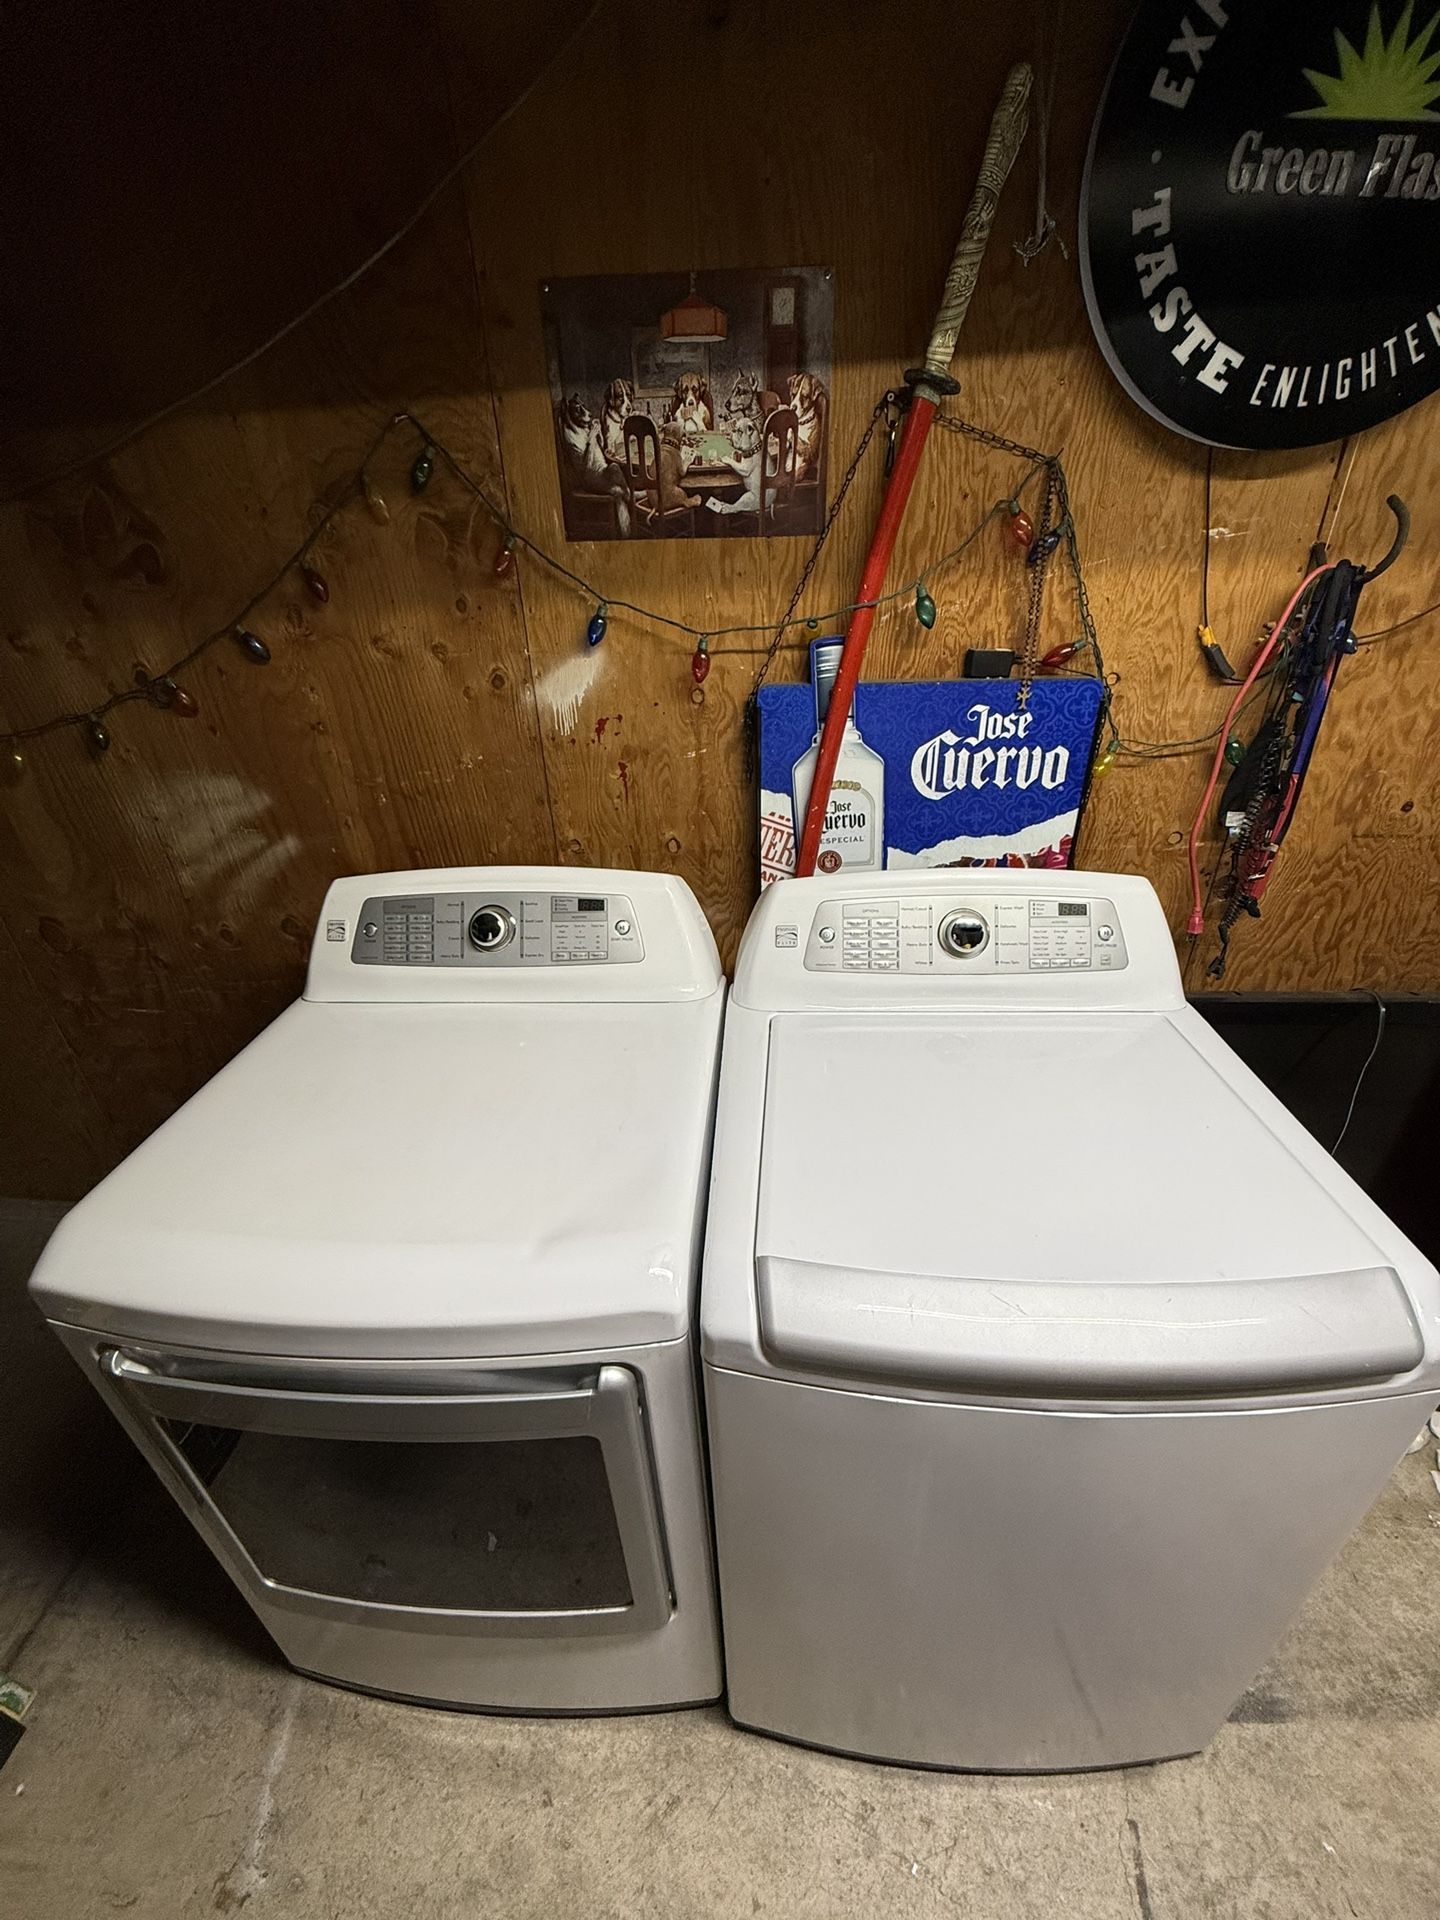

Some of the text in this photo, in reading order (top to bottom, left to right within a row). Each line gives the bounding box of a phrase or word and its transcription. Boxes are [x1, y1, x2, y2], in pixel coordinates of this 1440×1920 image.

[1226, 129, 1355, 196] Green
[1131, 186, 1245, 394] TASTE
[963, 704, 1034, 747] Jose
[910, 729, 1070, 801] Cuervo
[822, 812, 866, 834] uervo
[830, 800, 852, 815] Jose
